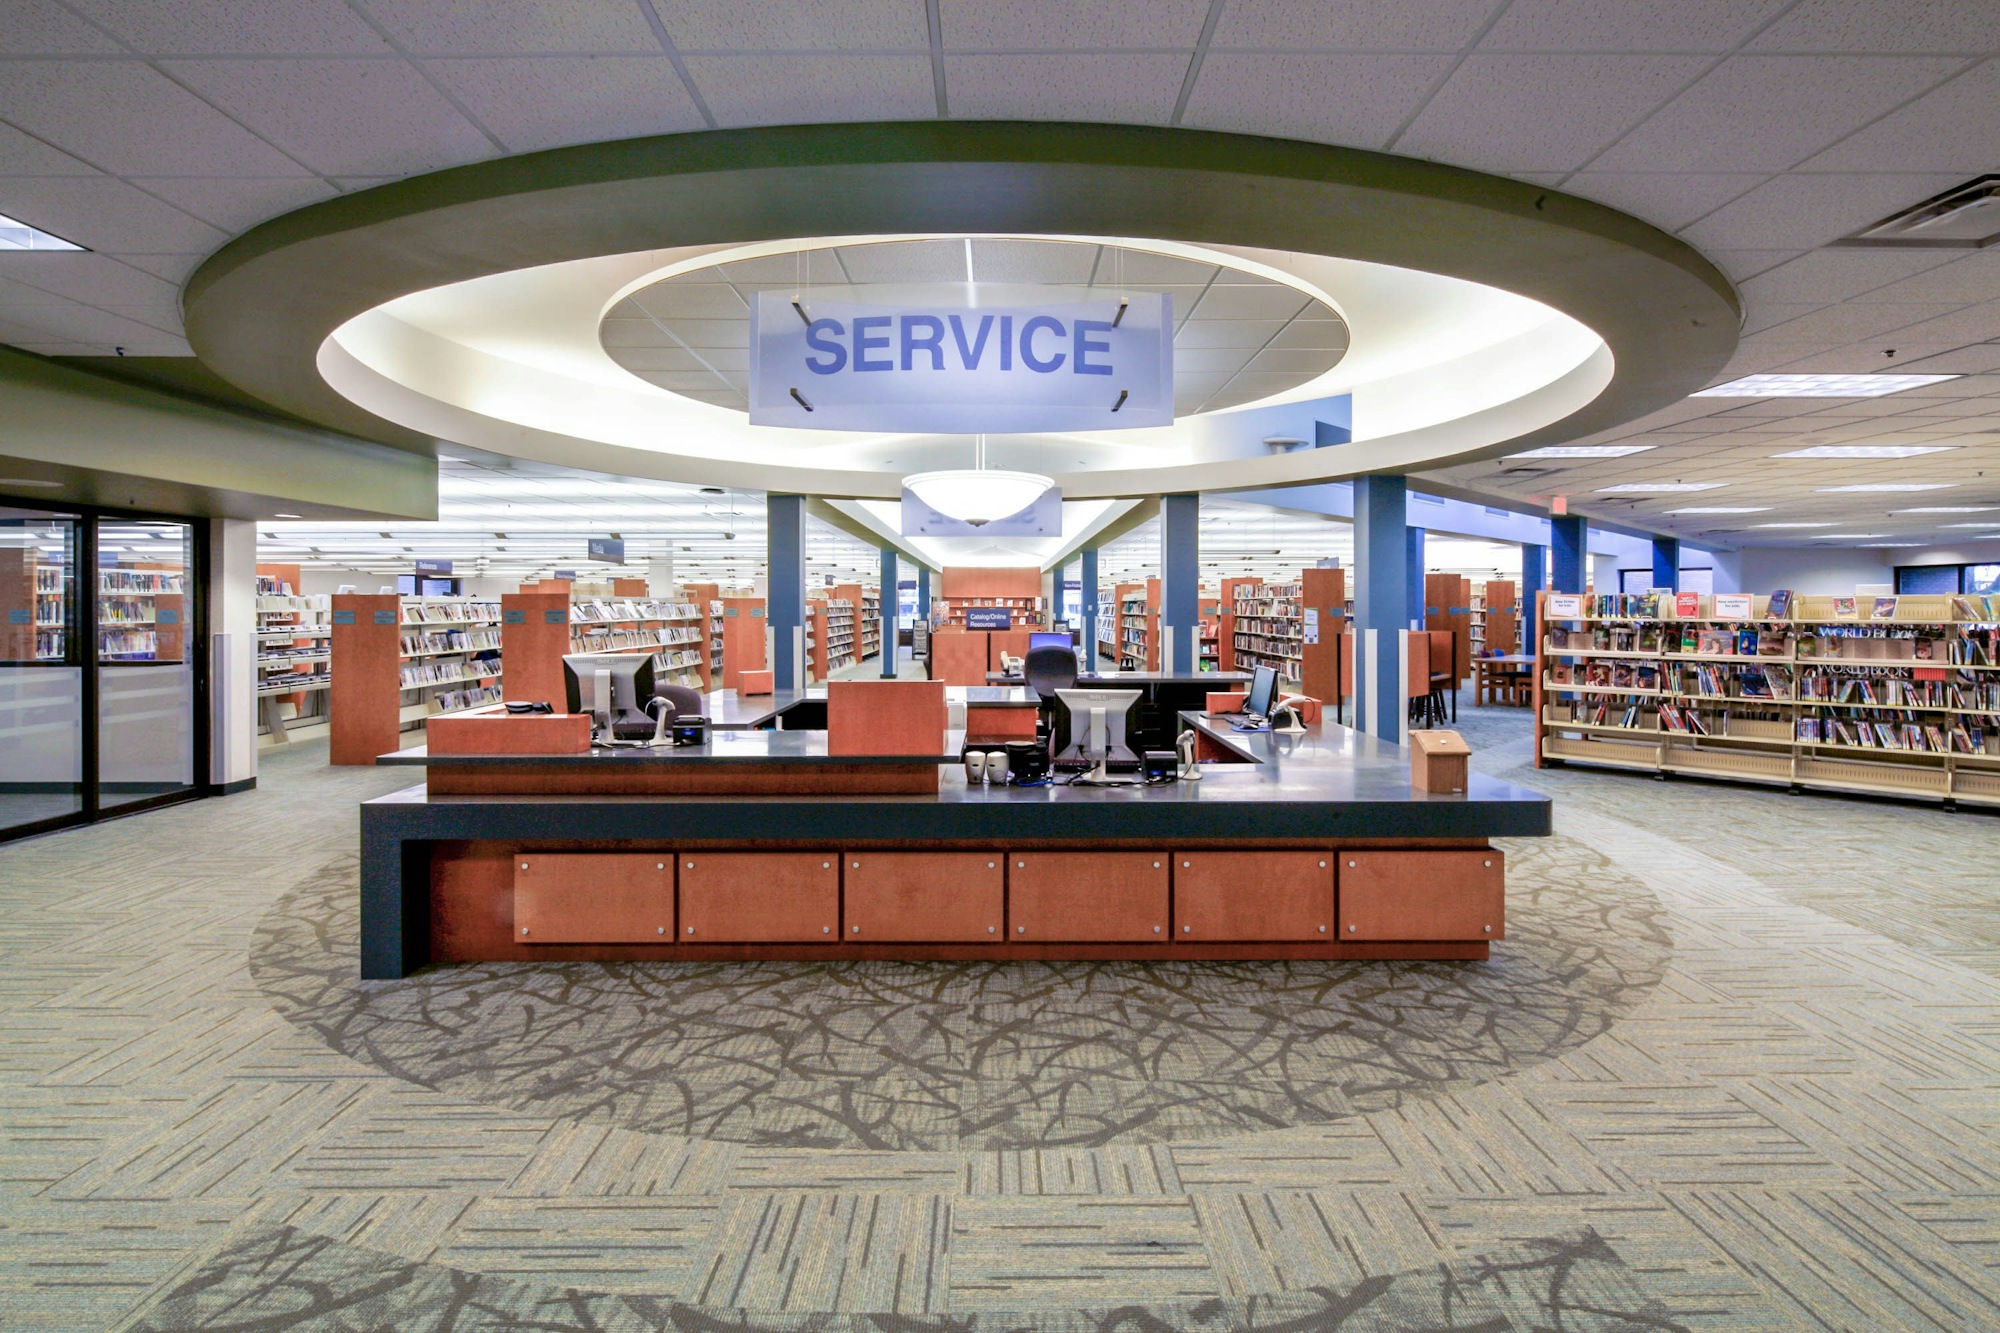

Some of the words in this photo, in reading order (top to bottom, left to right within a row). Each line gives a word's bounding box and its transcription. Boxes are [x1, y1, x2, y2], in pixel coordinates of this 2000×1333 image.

[805, 315, 1113, 375] SERVICE
[970, 613, 1007, 621] Catalog/Online
[1819, 627, 1871, 639] WORLD
[1817, 663, 1868, 675] WORLD
[1870, 665, 1908, 677] BOOK
